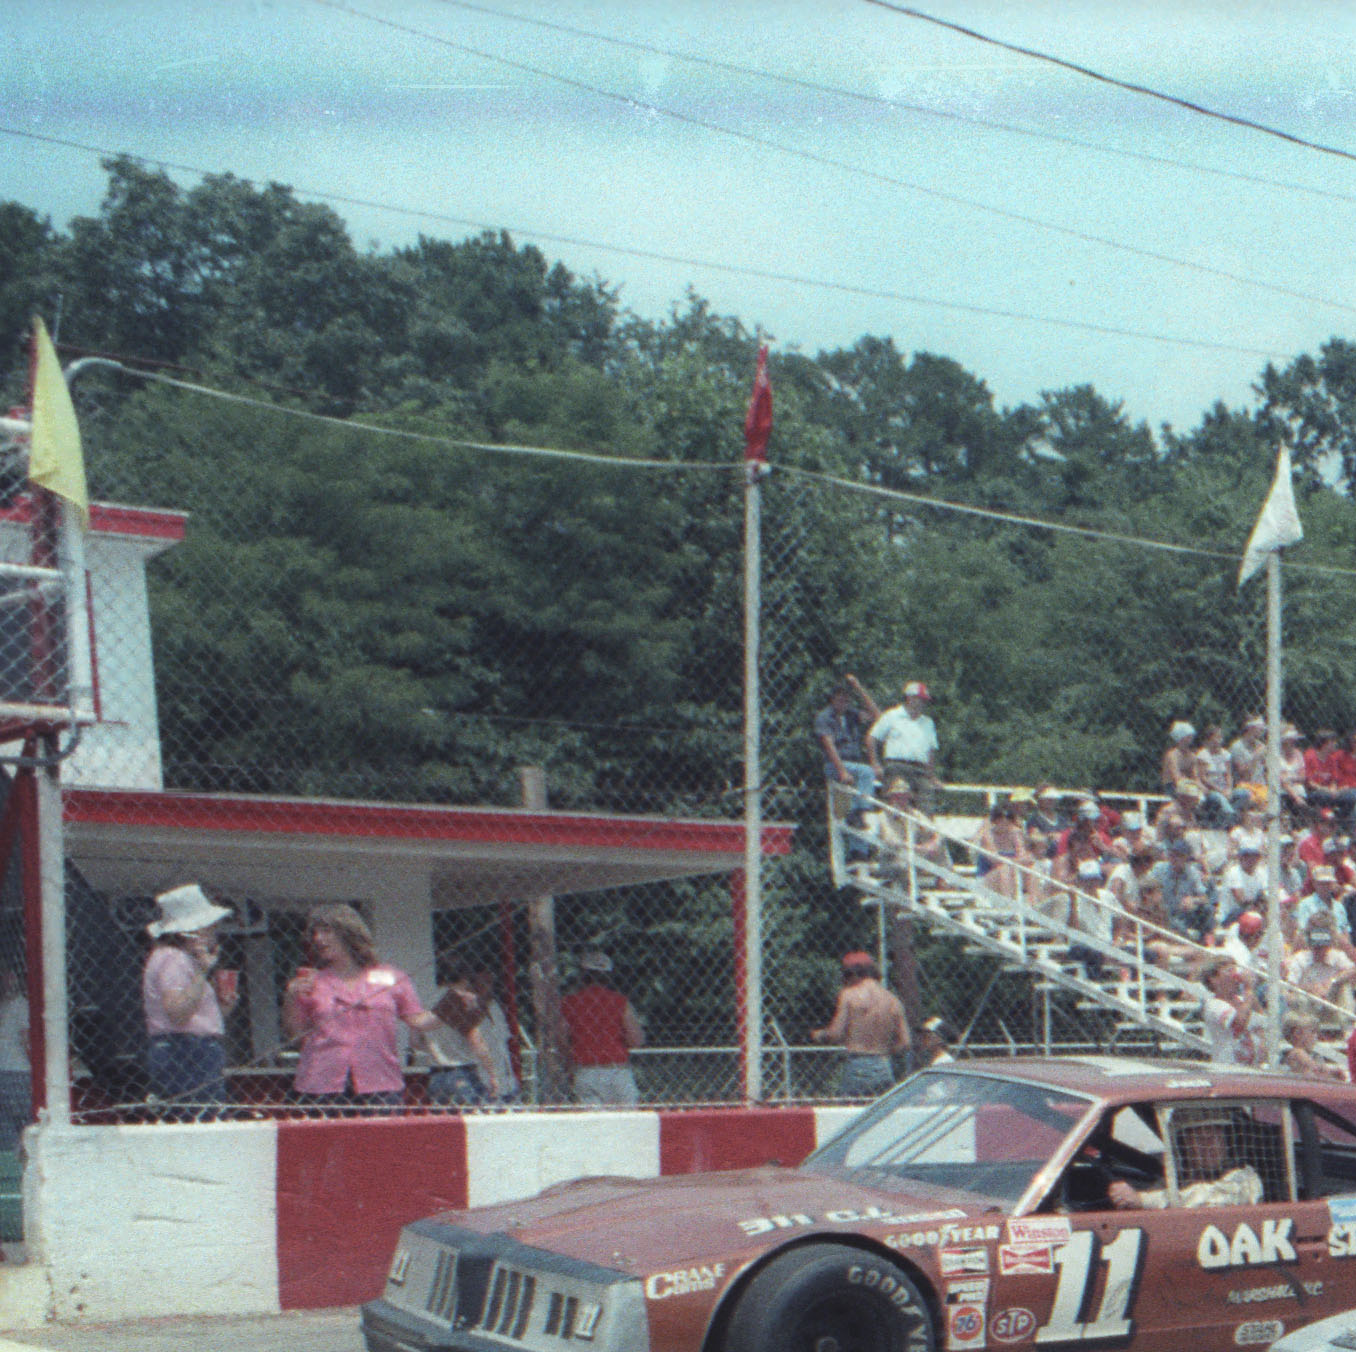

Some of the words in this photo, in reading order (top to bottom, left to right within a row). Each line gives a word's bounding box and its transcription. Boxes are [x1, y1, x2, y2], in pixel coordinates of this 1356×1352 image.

[885, 1223, 1000, 1249] GOODYEAR
[1198, 1218, 1298, 1268] OAK
[1035, 1228, 1141, 1343] 11
[956, 1314, 976, 1333] 76
[996, 1311, 1030, 1333] STP
